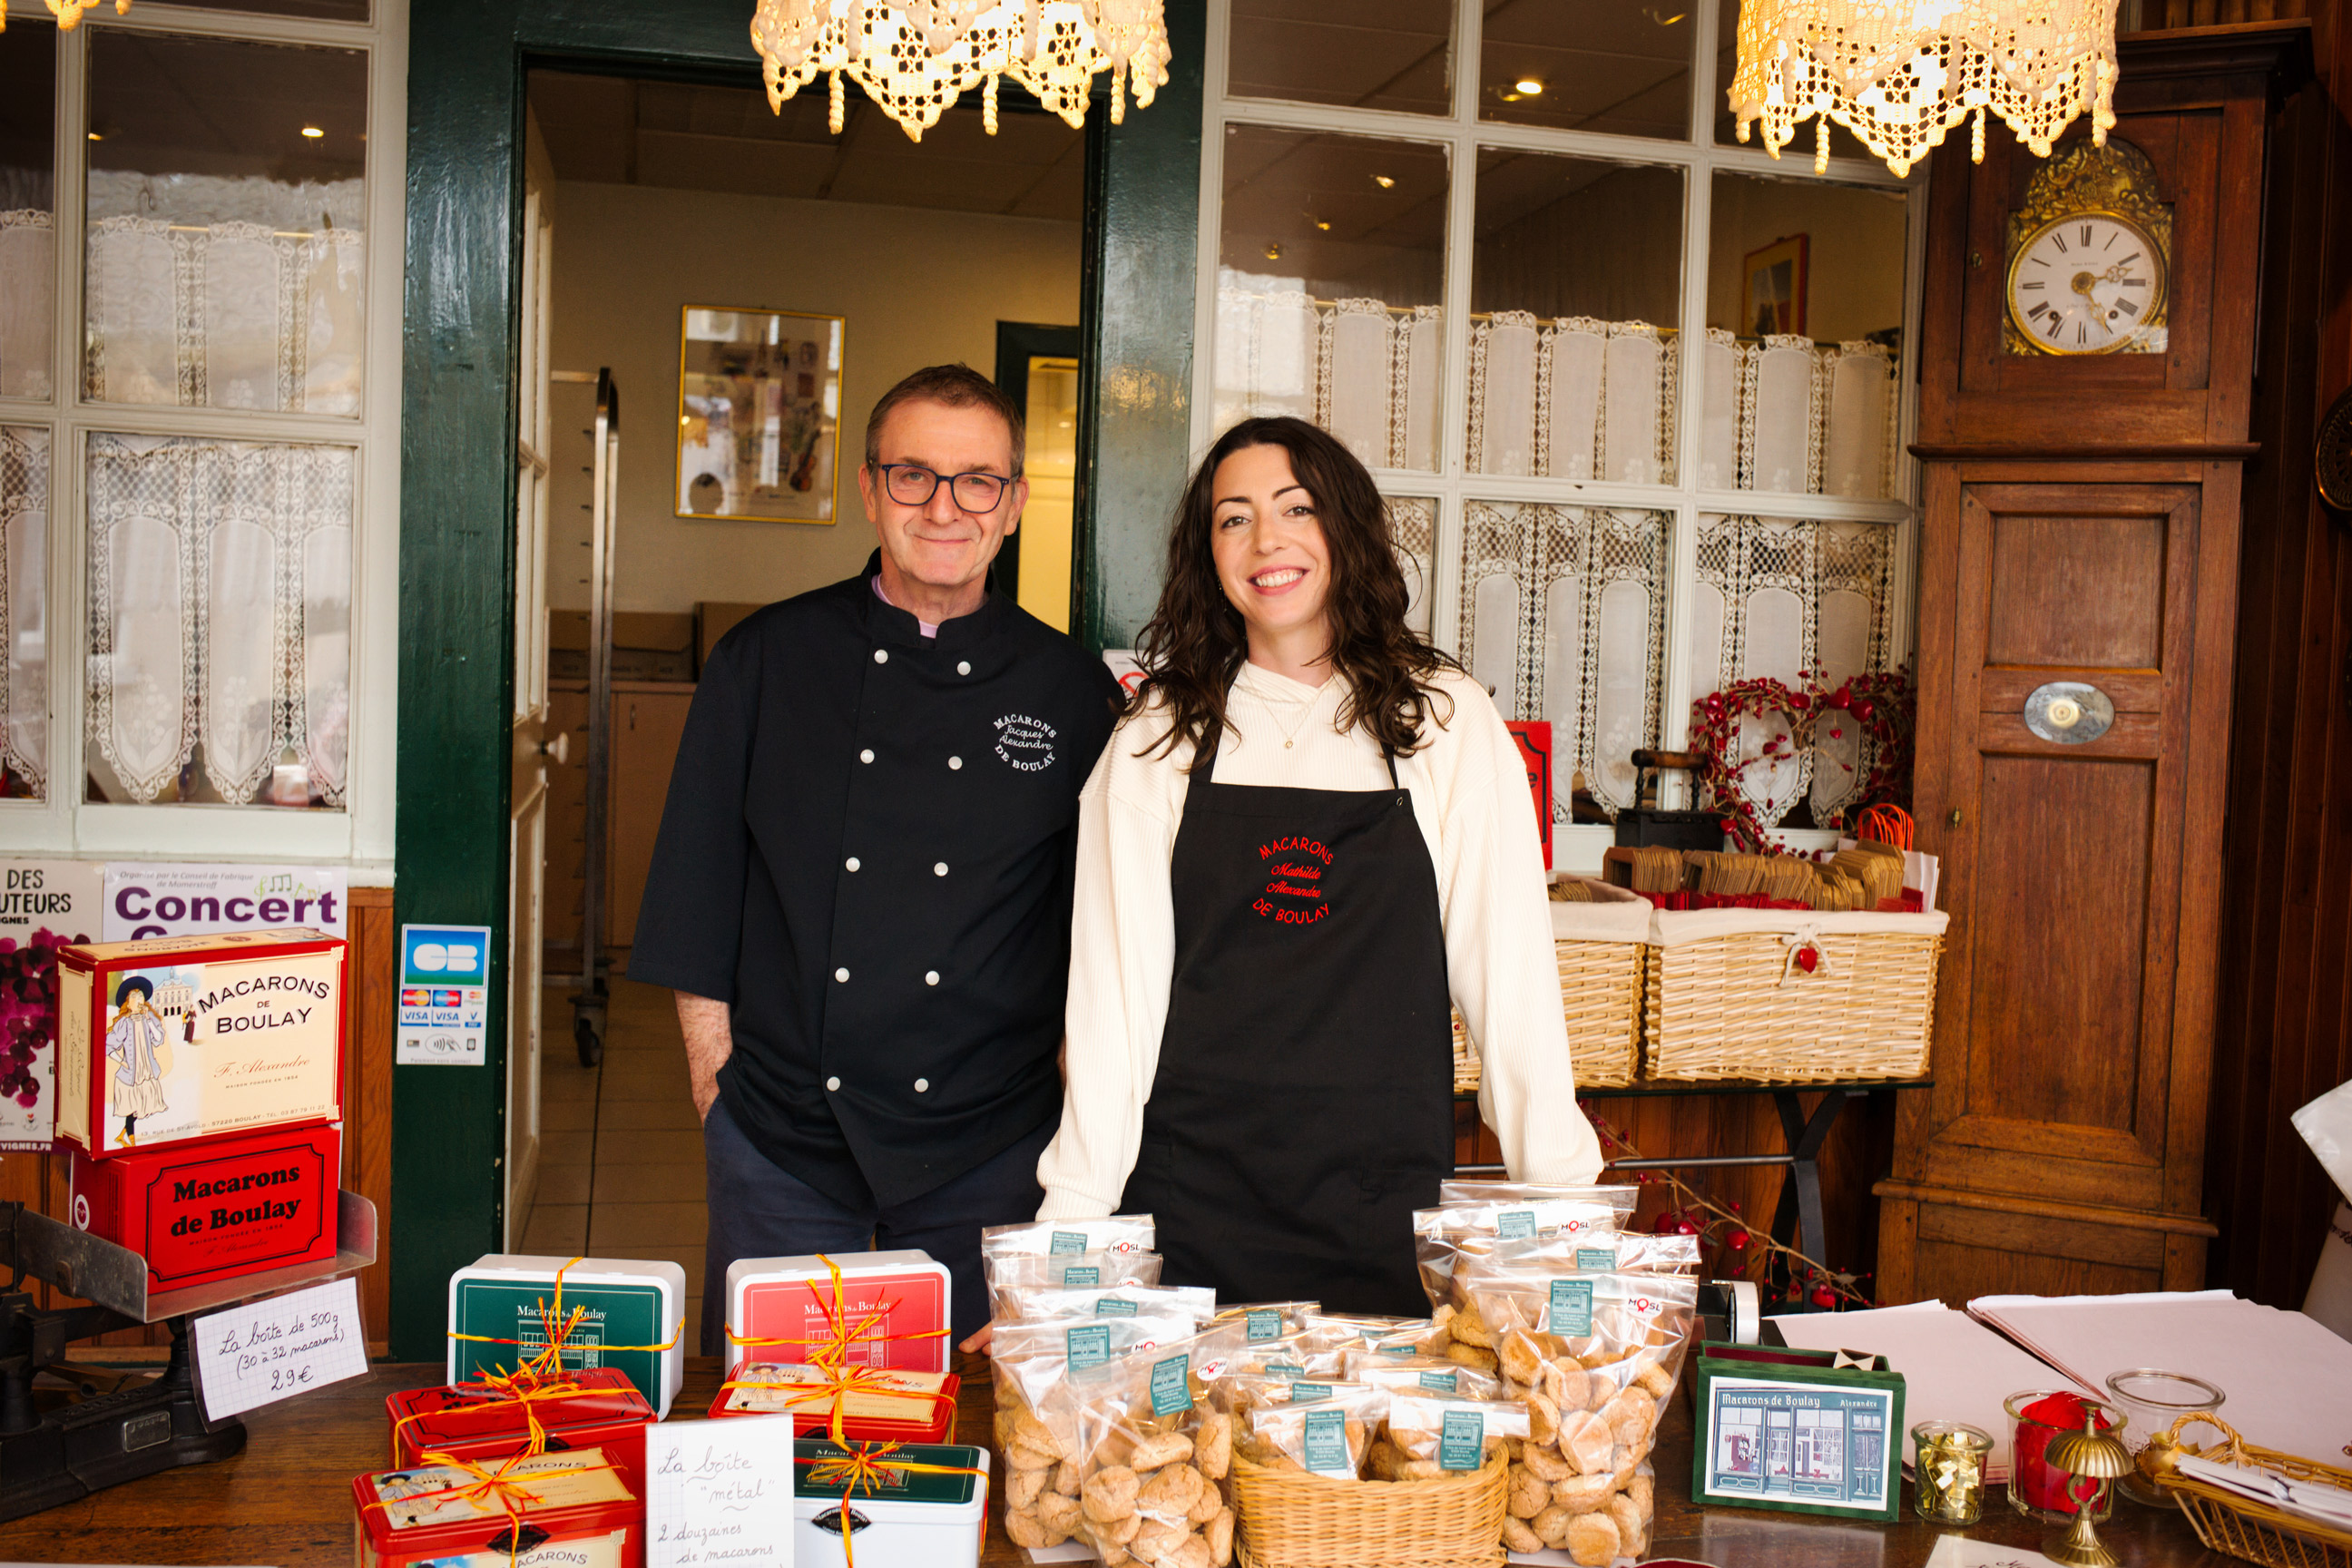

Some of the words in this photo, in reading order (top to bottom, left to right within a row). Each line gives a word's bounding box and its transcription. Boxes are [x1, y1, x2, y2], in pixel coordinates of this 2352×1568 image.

[994, 714, 1056, 738] MACARONS
[1004, 725, 1044, 740] Jacques
[999, 735, 1054, 750] Alexandre
[995, 744, 1010, 762] DE
[1012, 751, 1055, 771] BOULAY
[1259, 837, 1333, 865] MACARONS
[7, 869, 44, 889] DES
[156, 872, 169, 880] par
[172, 871, 179, 879] le
[181, 871, 208, 879] Conseil
[220, 872, 254, 881] Fabrique
[1271, 862, 1321, 879] Mathilde
[1267, 880, 1321, 897] Alexandre
[115, 887, 338, 923] Concert
[1252, 897, 1273, 916] DE
[1275, 903, 1329, 924] BOULAY
[413, 943, 478, 972] CB
[197, 975, 329, 1014] MACARONS
[216, 1007, 312, 1034] BOULAY
[405, 1012, 428, 1021] VISA
[436, 1012, 459, 1022] VISA
[237, 1054, 310, 1073] Alexandre
[234, 1114, 261, 1122] BOULAY
[173, 1166, 300, 1203] Macarons
[171, 1215, 202, 1237] de
[210, 1199, 301, 1230] Boulay
[1562, 1220, 1589, 1231] MOSL
[1628, 1298, 1661, 1312] MOSL
[219, 1330, 241, 1356] La
[246, 1321, 283, 1348] boîte
[289, 1315, 305, 1336] de
[237, 1354, 258, 1380] (30
[261, 1351, 270, 1363] à
[272, 1347, 287, 1359] 32
[271, 1366, 314, 1391] 29€
[1722, 1394, 1769, 1406] Macarons
[1771, 1395, 1782, 1406] de
[1786, 1395, 1820, 1408] Boulay
[1840, 1399, 1877, 1407] Alexandre
[658, 1447, 687, 1475] La
[694, 1445, 752, 1474] boîte
[658, 1524, 668, 1543] 2
[673, 1522, 742, 1546] douzaines
[510, 1551, 588, 1568] ACARONS
[676, 1548, 698, 1564] de
[704, 1544, 773, 1563] macarons
